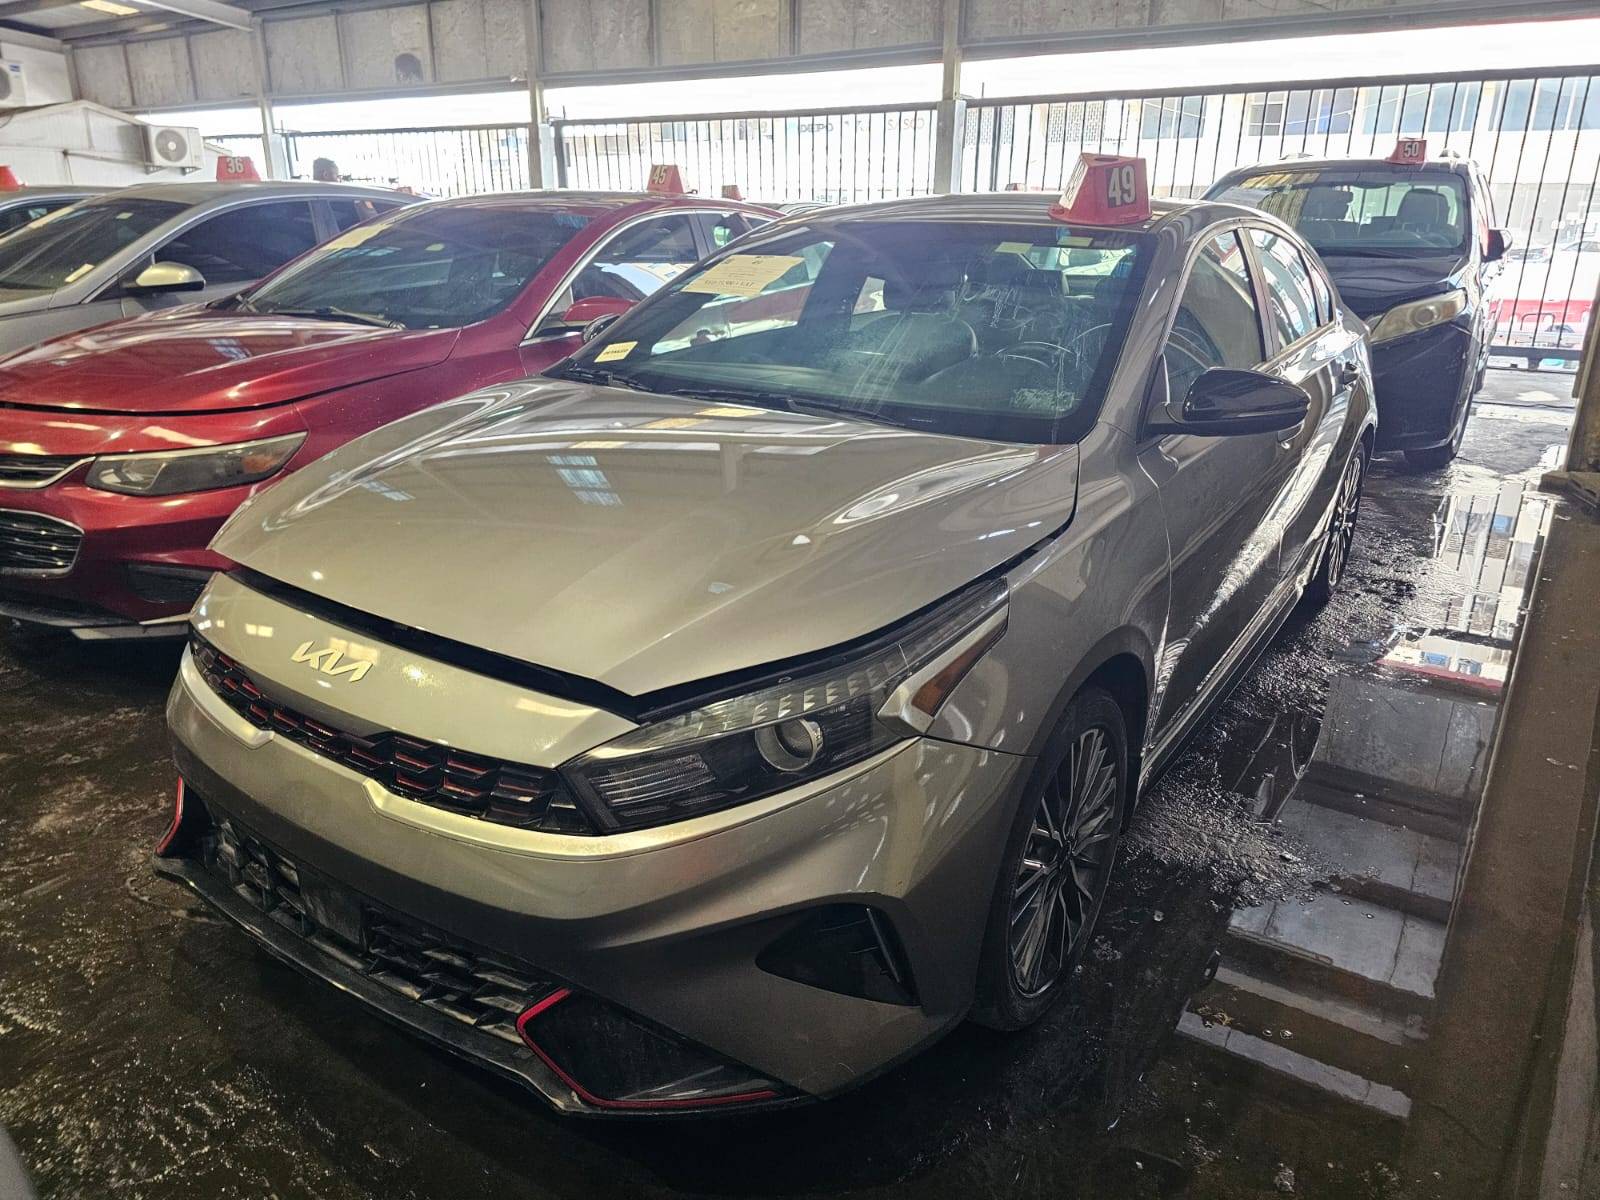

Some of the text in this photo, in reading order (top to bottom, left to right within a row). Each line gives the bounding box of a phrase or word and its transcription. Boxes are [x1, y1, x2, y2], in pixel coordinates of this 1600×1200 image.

[1404, 141, 1419, 158] 50
[226, 157, 244, 174] 36
[653, 165, 667, 185] 45
[1108, 165, 1136, 206] 49
[290, 640, 374, 683] KIA
